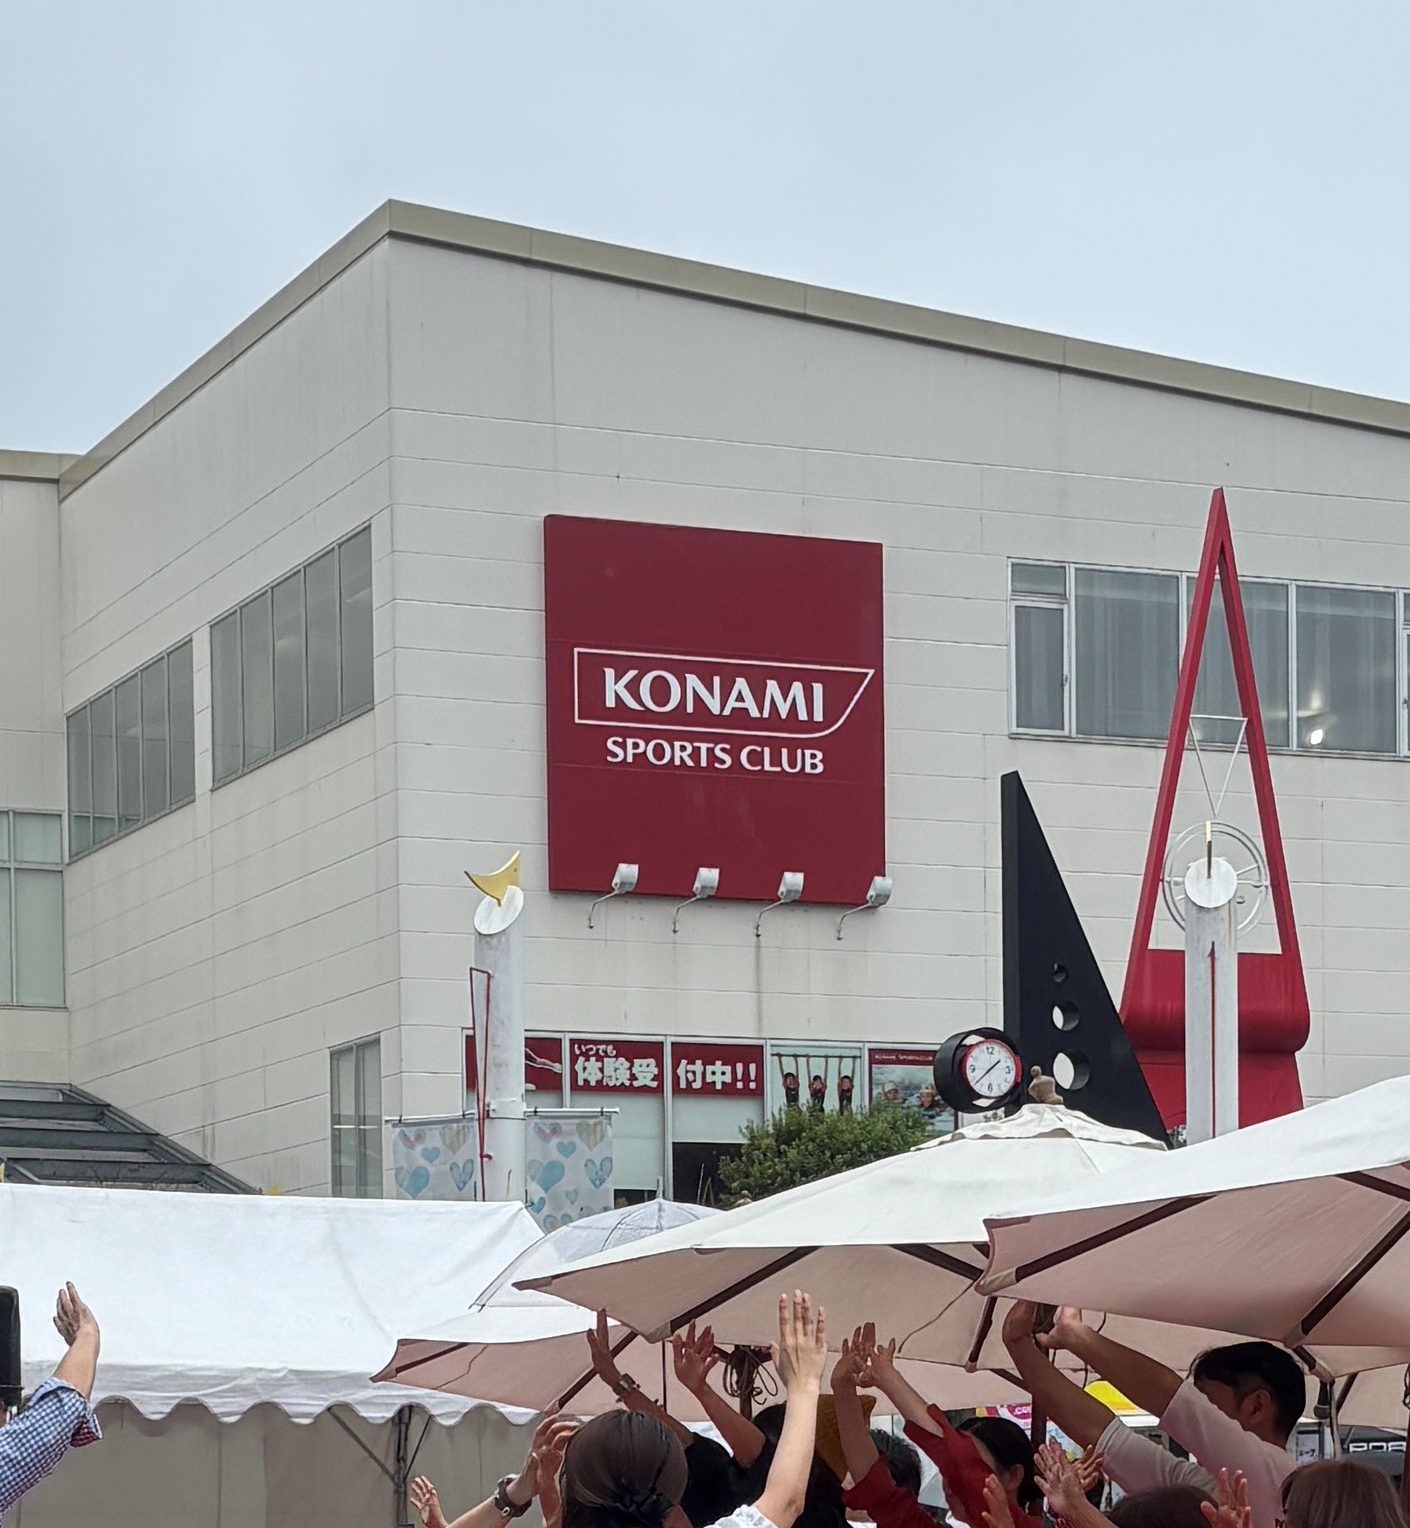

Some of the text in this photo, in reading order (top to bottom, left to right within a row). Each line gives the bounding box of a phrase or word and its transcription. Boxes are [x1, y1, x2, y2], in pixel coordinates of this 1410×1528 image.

[603, 667, 824, 722] KONAMI
[606, 736, 824, 774] SPORTS CLUB
[574, 1044, 617, 1056] いつでも
